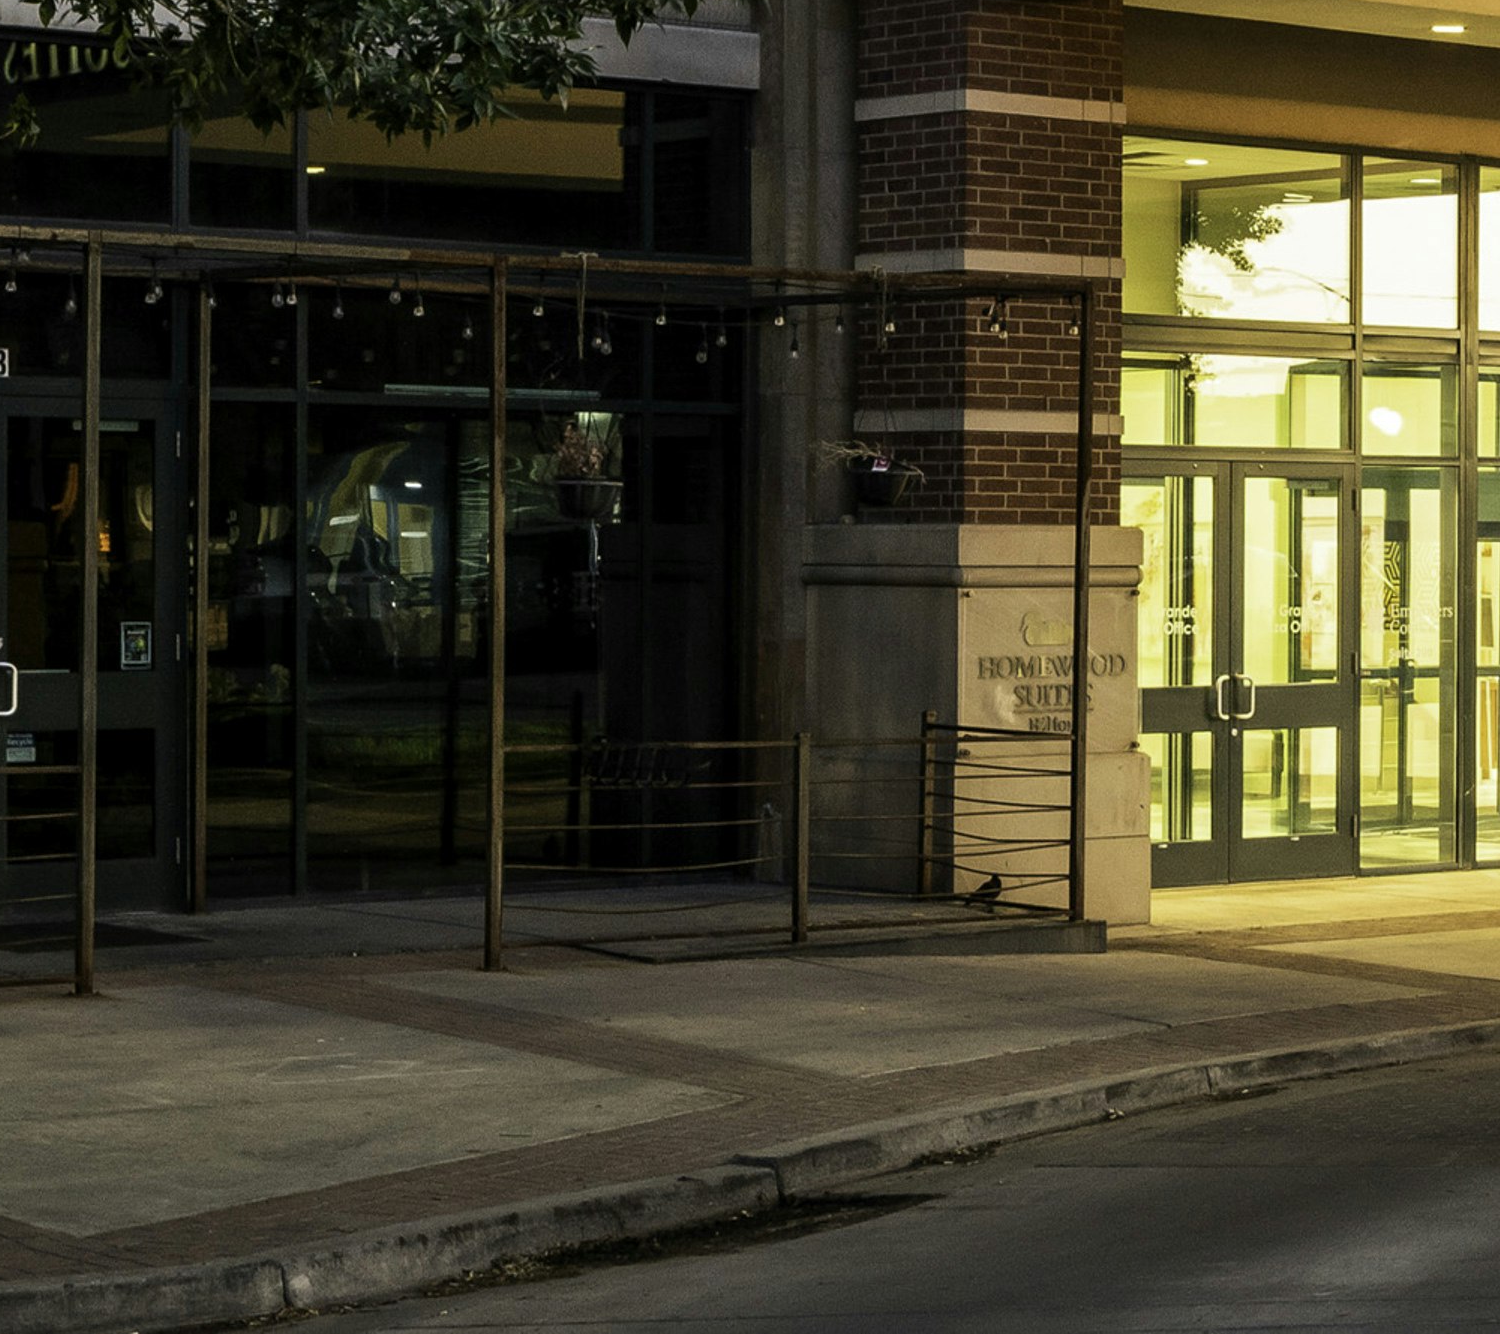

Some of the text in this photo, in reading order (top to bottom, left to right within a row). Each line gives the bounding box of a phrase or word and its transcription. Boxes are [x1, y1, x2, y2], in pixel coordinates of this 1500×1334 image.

[977, 655, 1127, 679] HOMEWOD
[1013, 684, 1094, 708] SUITS
[1029, 715, 1074, 732] Hilto
